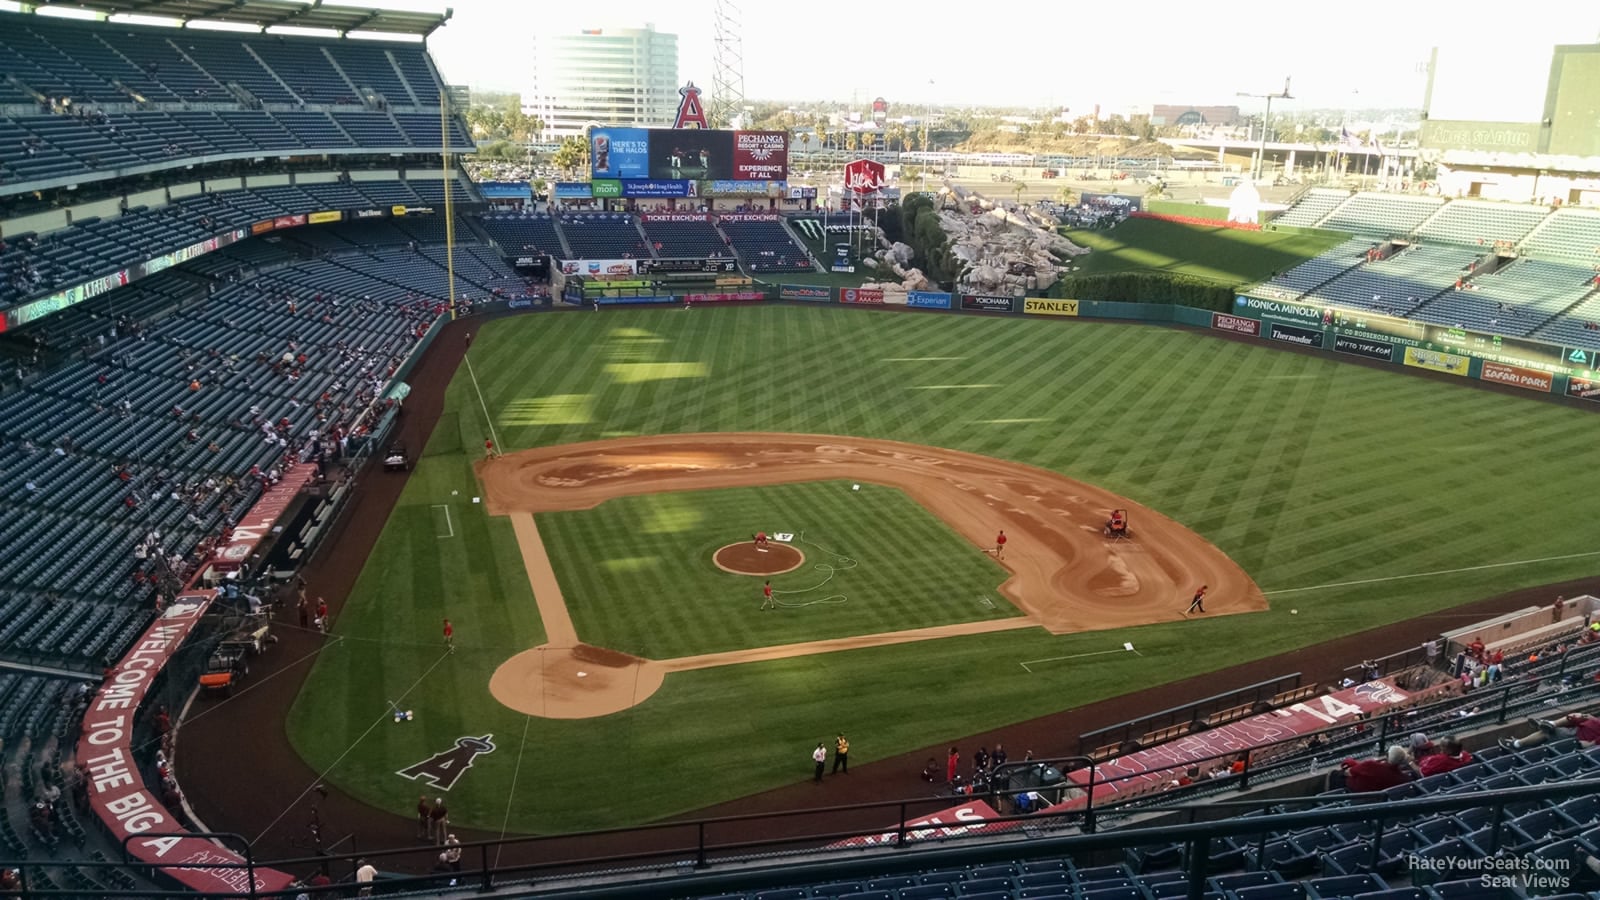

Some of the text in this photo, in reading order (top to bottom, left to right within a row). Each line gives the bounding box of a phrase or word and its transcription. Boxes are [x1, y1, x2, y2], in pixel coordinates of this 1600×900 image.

[738, 135, 784, 144] PECHANGA
[917, 296, 947, 305] Experian
[975, 297, 1010, 305] YOKOHAMA
[1025, 301, 1077, 312] STANLEY
[1247, 299, 1320, 319] KONICA MINOLTA
[1217, 316, 1256, 329] PECHANGA
[1272, 330, 1313, 345] Thermador
[1390, 336, 1419, 347] SERVICES
[1484, 369, 1548, 388] SAFARI PARK
[1274, 694, 1364, 724] '14
[87, 622, 185, 857] WELCOME TO THE BIG A
